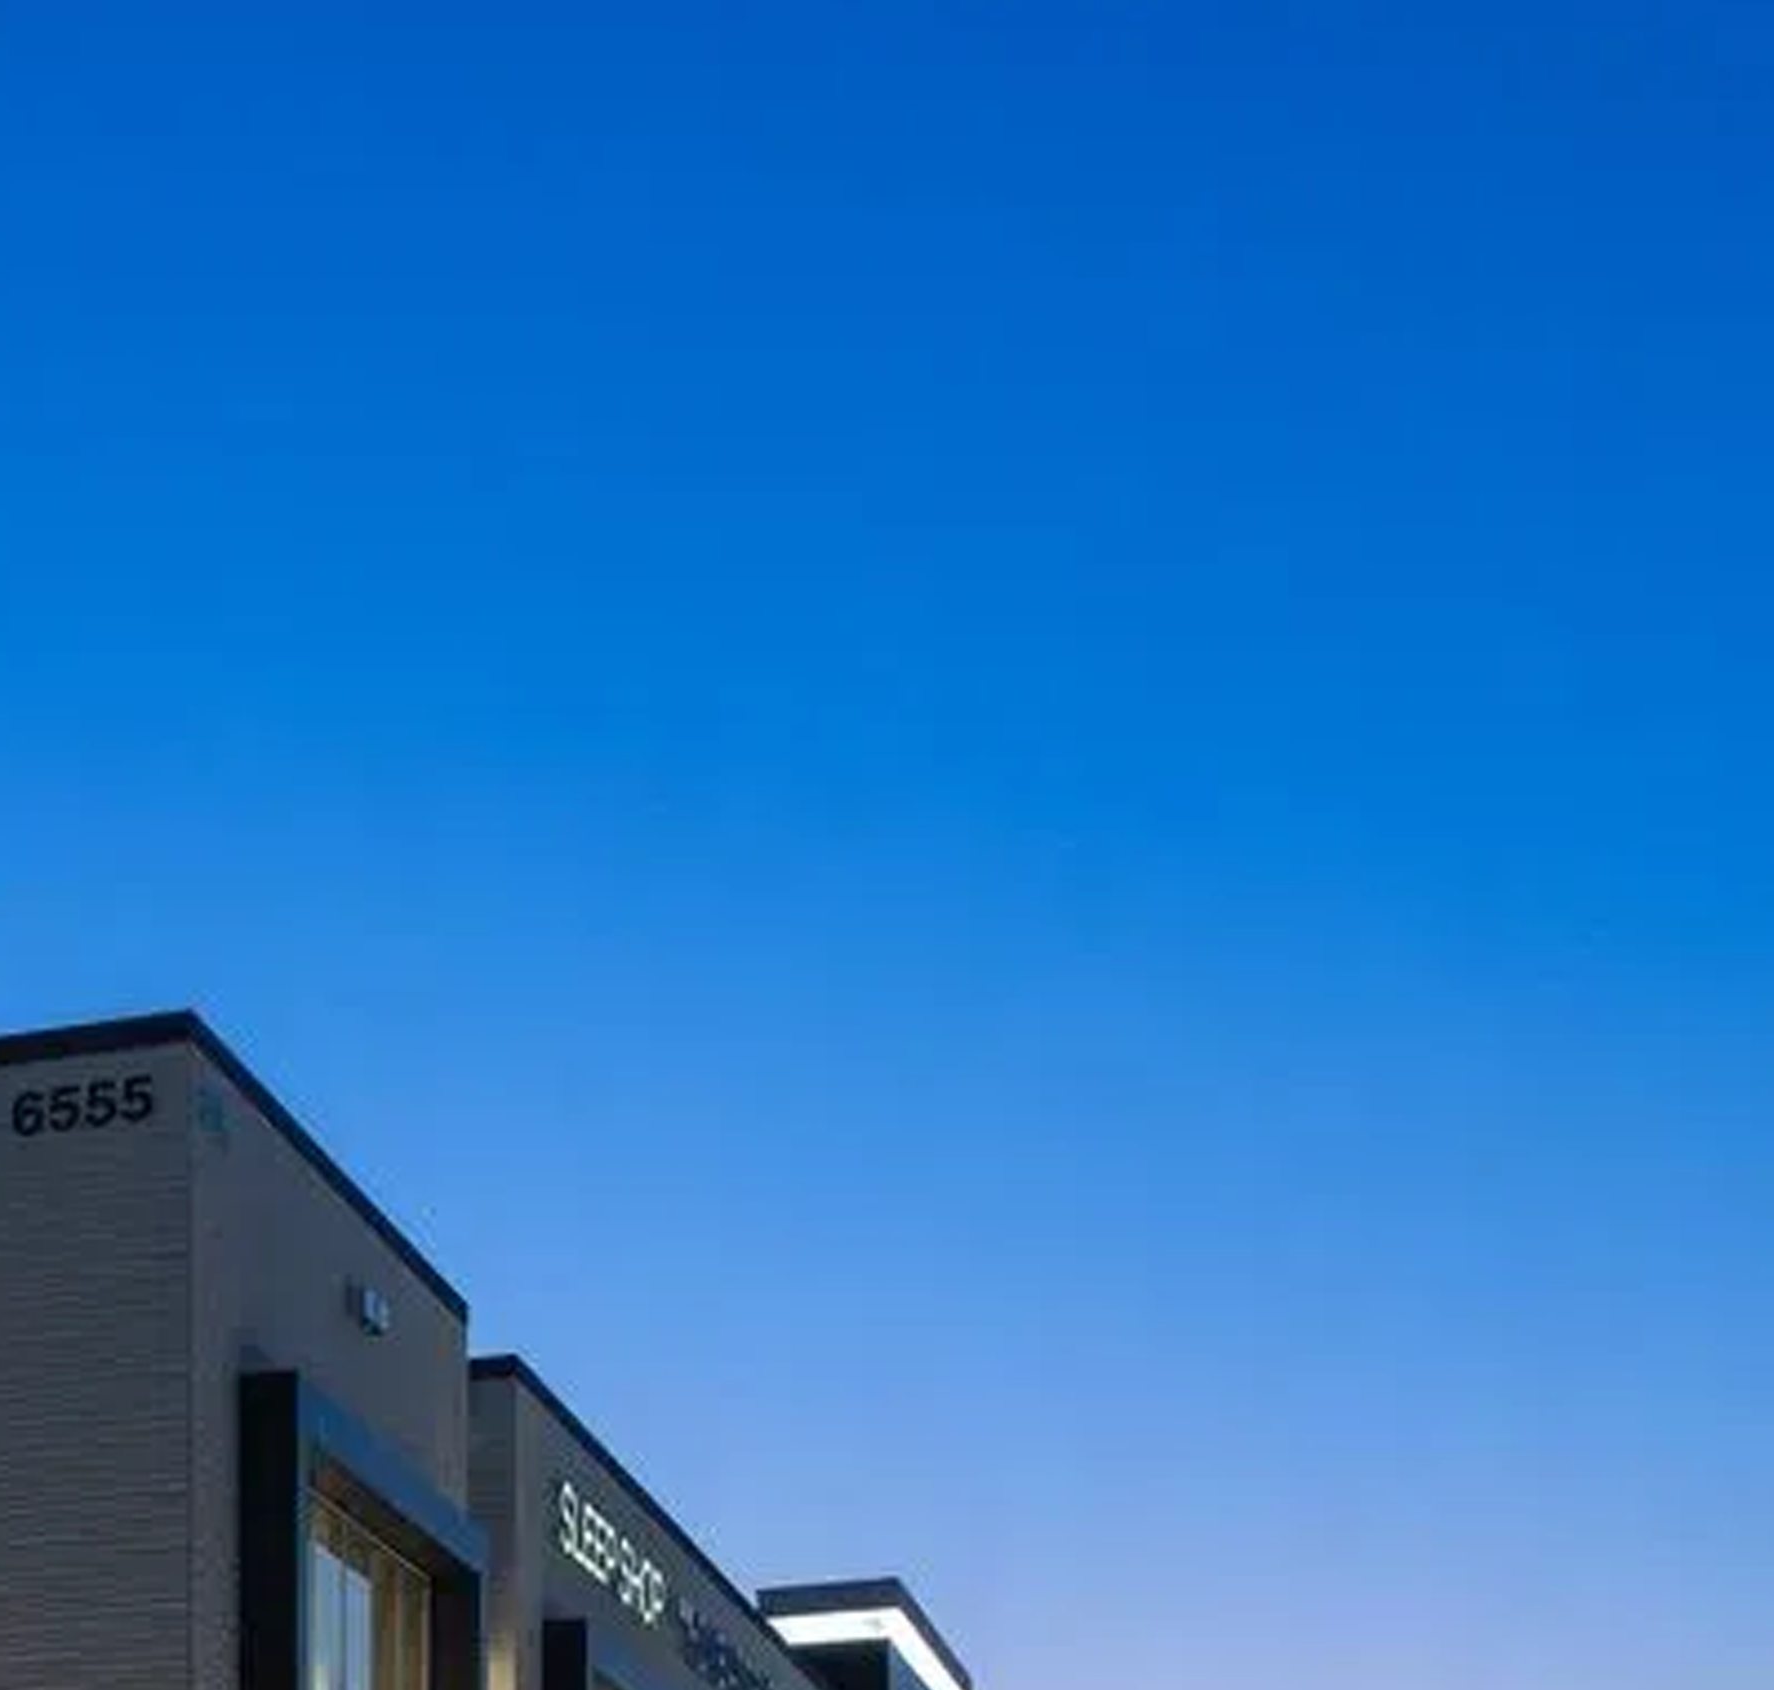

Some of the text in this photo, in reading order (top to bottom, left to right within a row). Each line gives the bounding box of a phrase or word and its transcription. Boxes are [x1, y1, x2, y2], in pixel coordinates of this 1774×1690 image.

[13, 1074, 153, 1137] 6555
[560, 1481, 666, 1628] SLEEP SHOP
